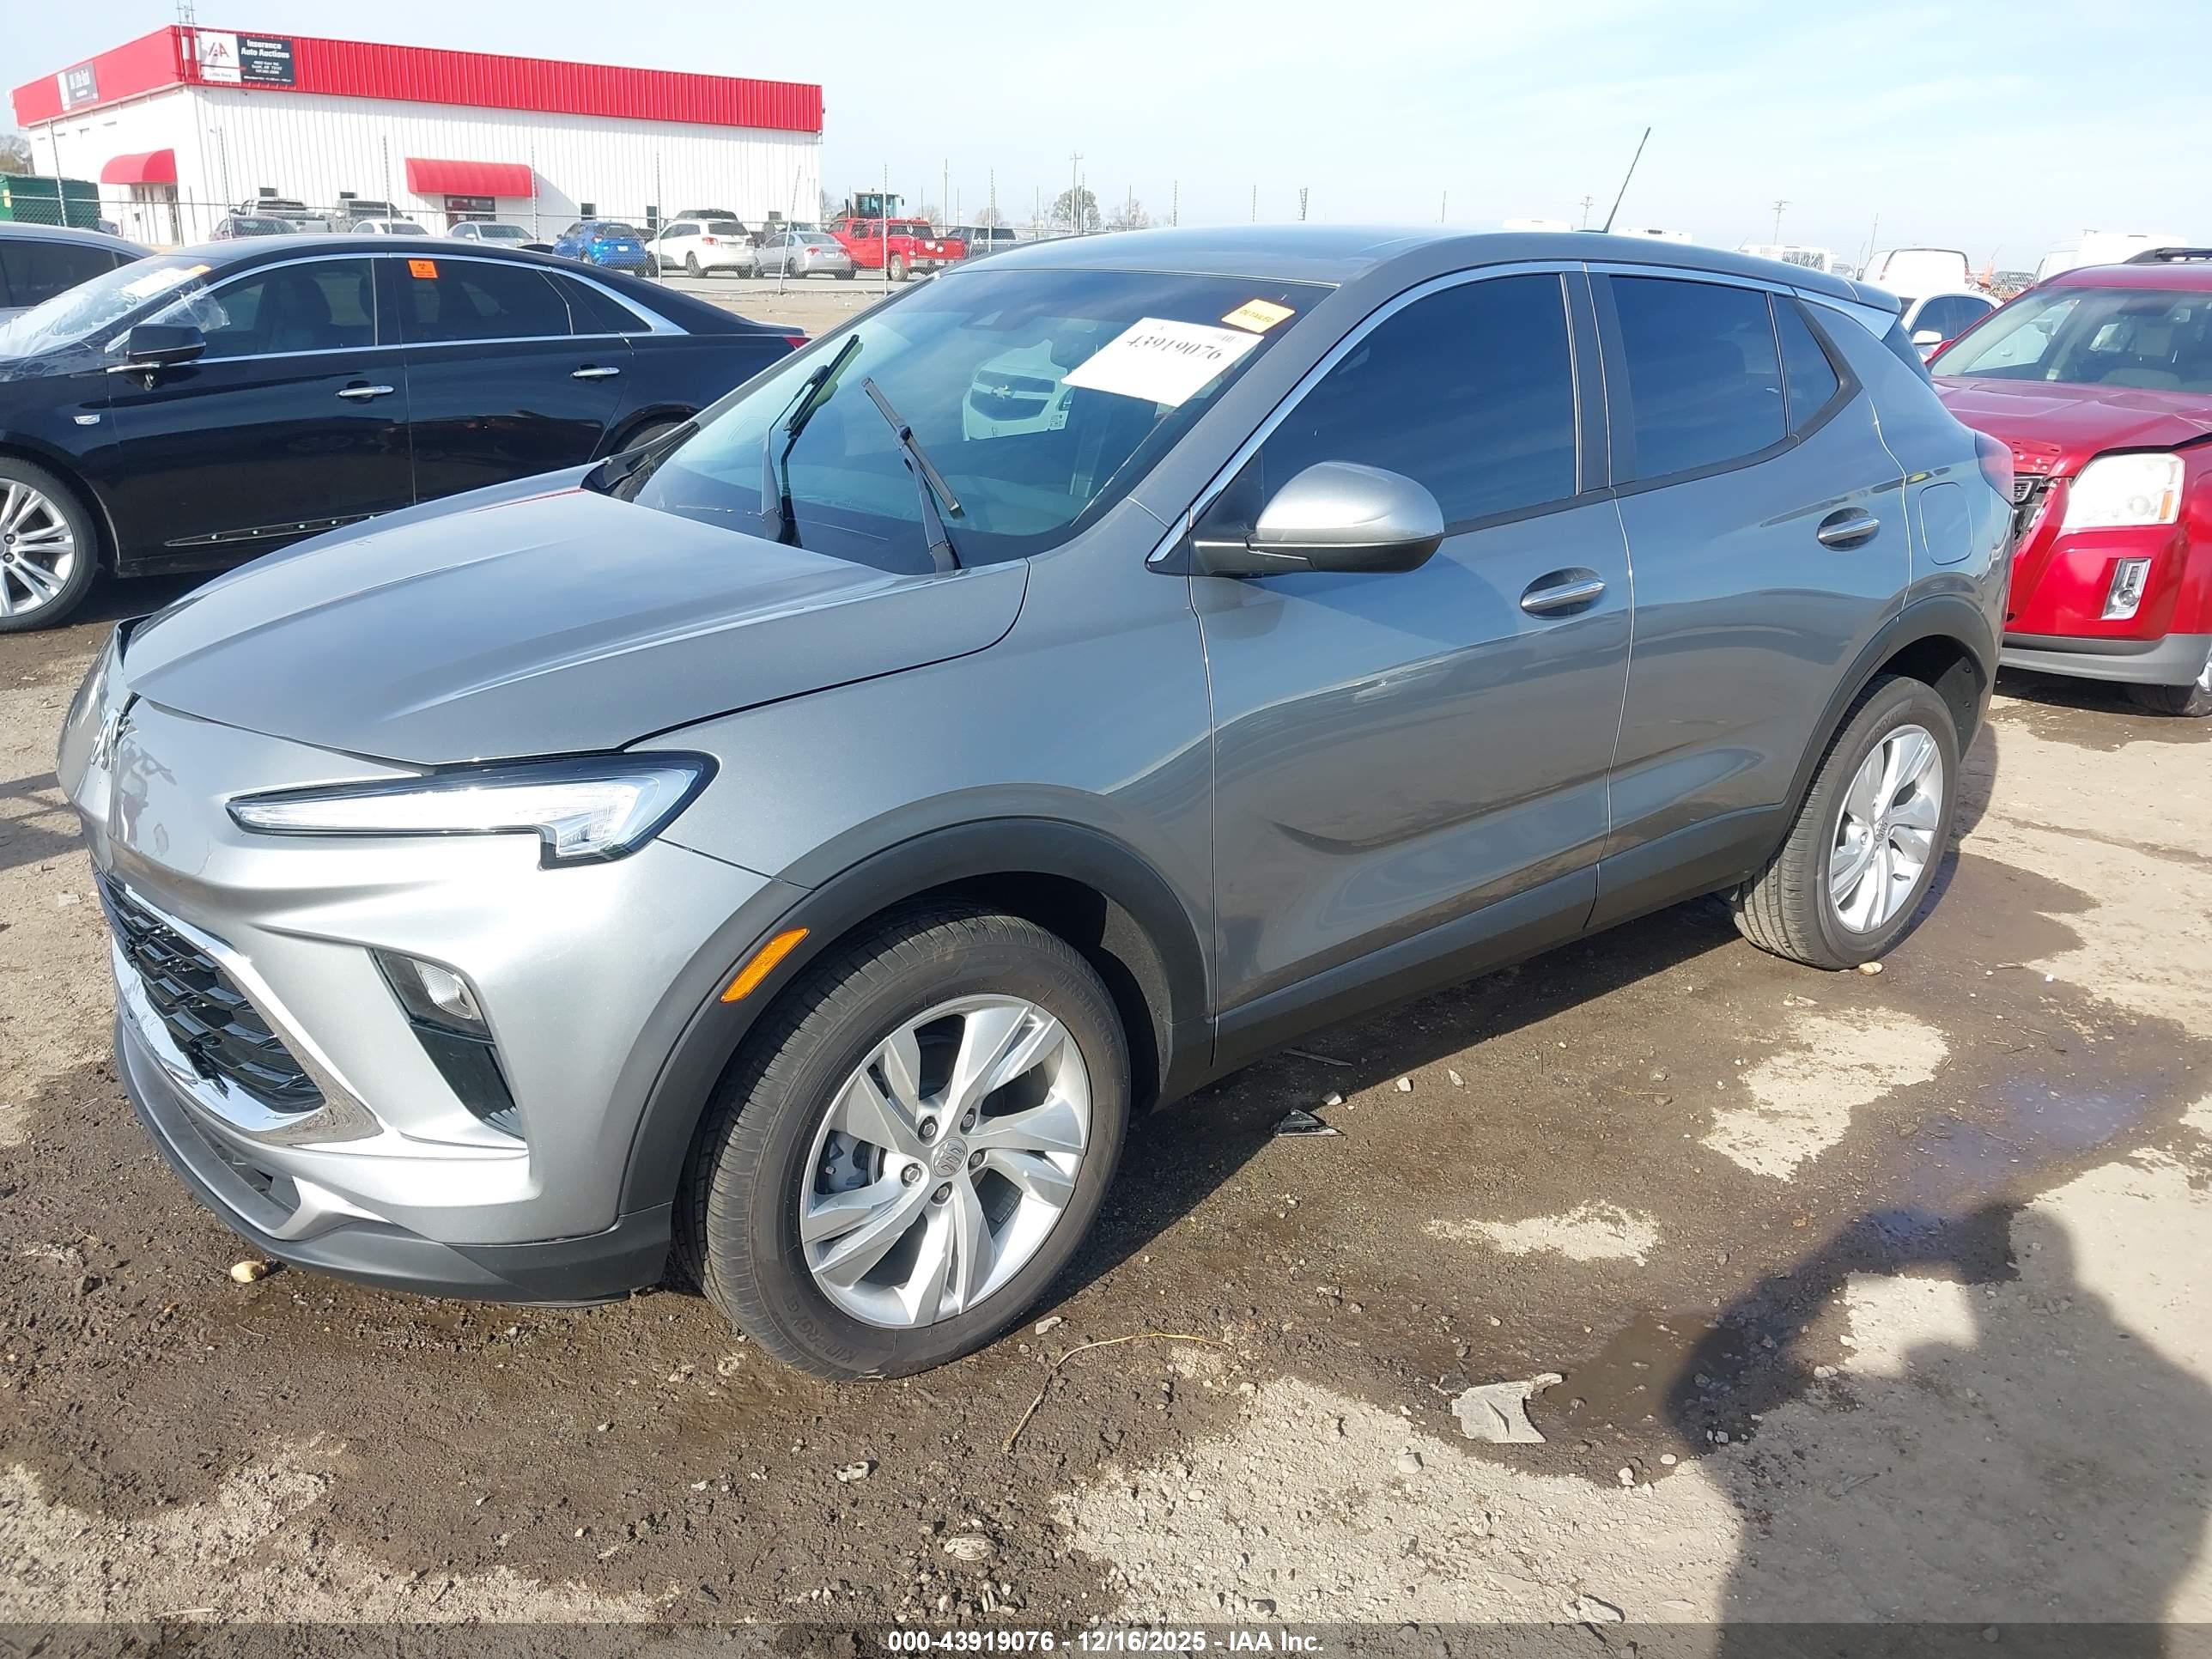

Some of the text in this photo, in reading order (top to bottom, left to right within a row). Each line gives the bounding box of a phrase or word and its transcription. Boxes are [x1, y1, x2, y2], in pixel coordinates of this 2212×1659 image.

[246, 40, 283, 49] Insurance
[240, 47, 290, 58] Auto Auctions
[1239, 309, 1275, 323] DETAILED
[1127, 335, 1223, 360] 43919076
